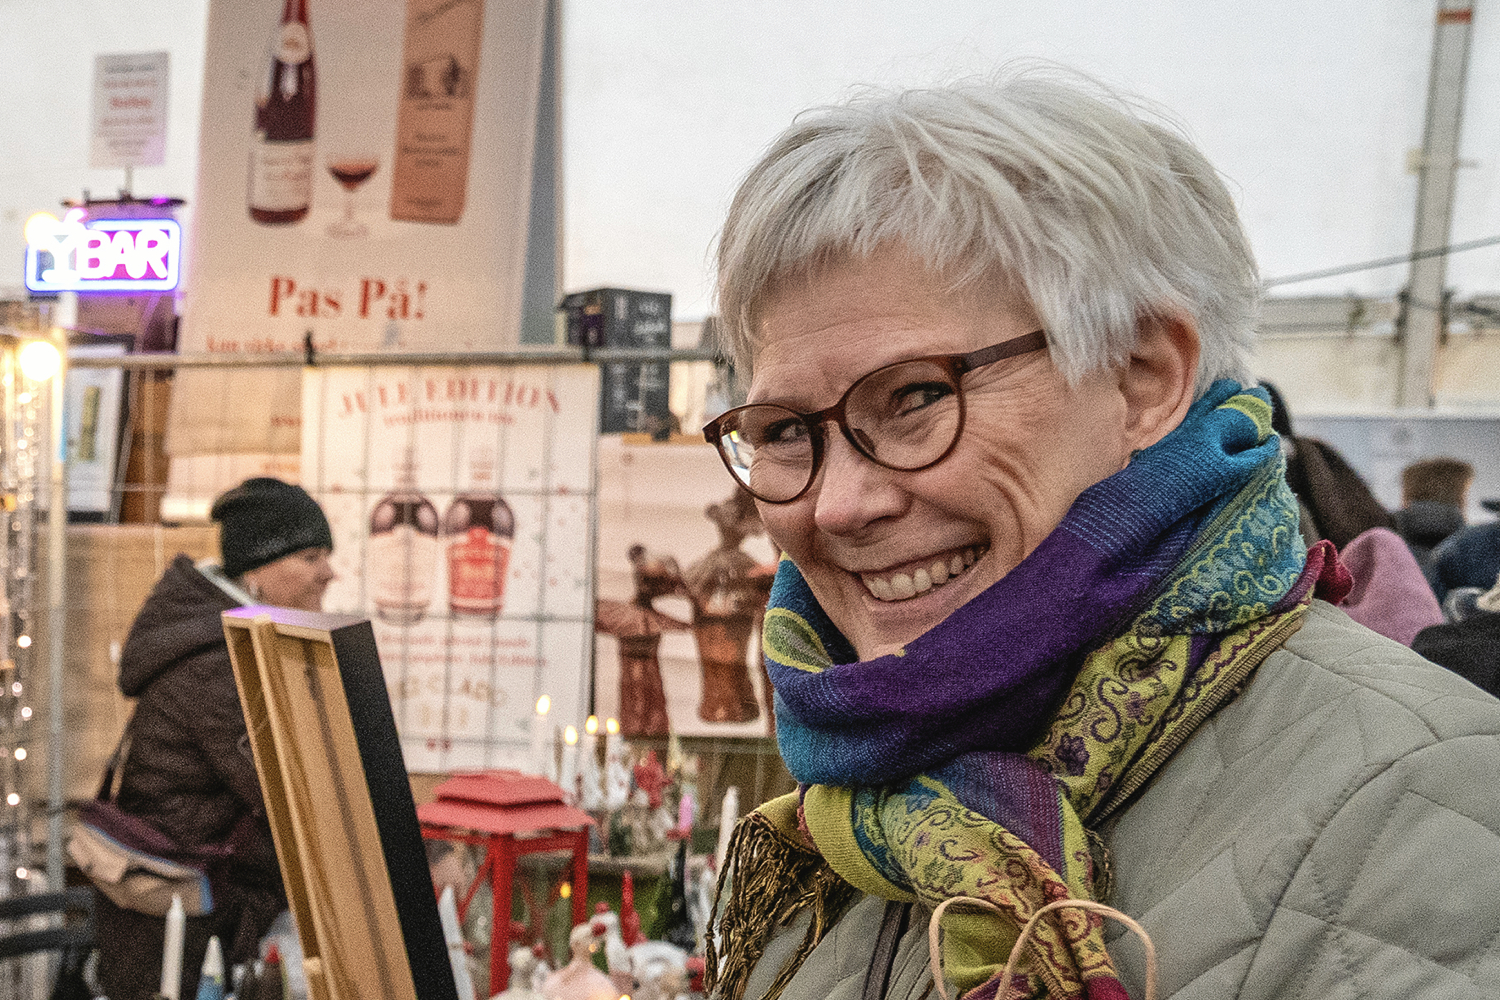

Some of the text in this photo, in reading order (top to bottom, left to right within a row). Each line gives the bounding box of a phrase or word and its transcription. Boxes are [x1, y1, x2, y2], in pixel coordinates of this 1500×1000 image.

[81, 229, 168, 279] BAR
[268, 275, 428, 319] Pas På!
